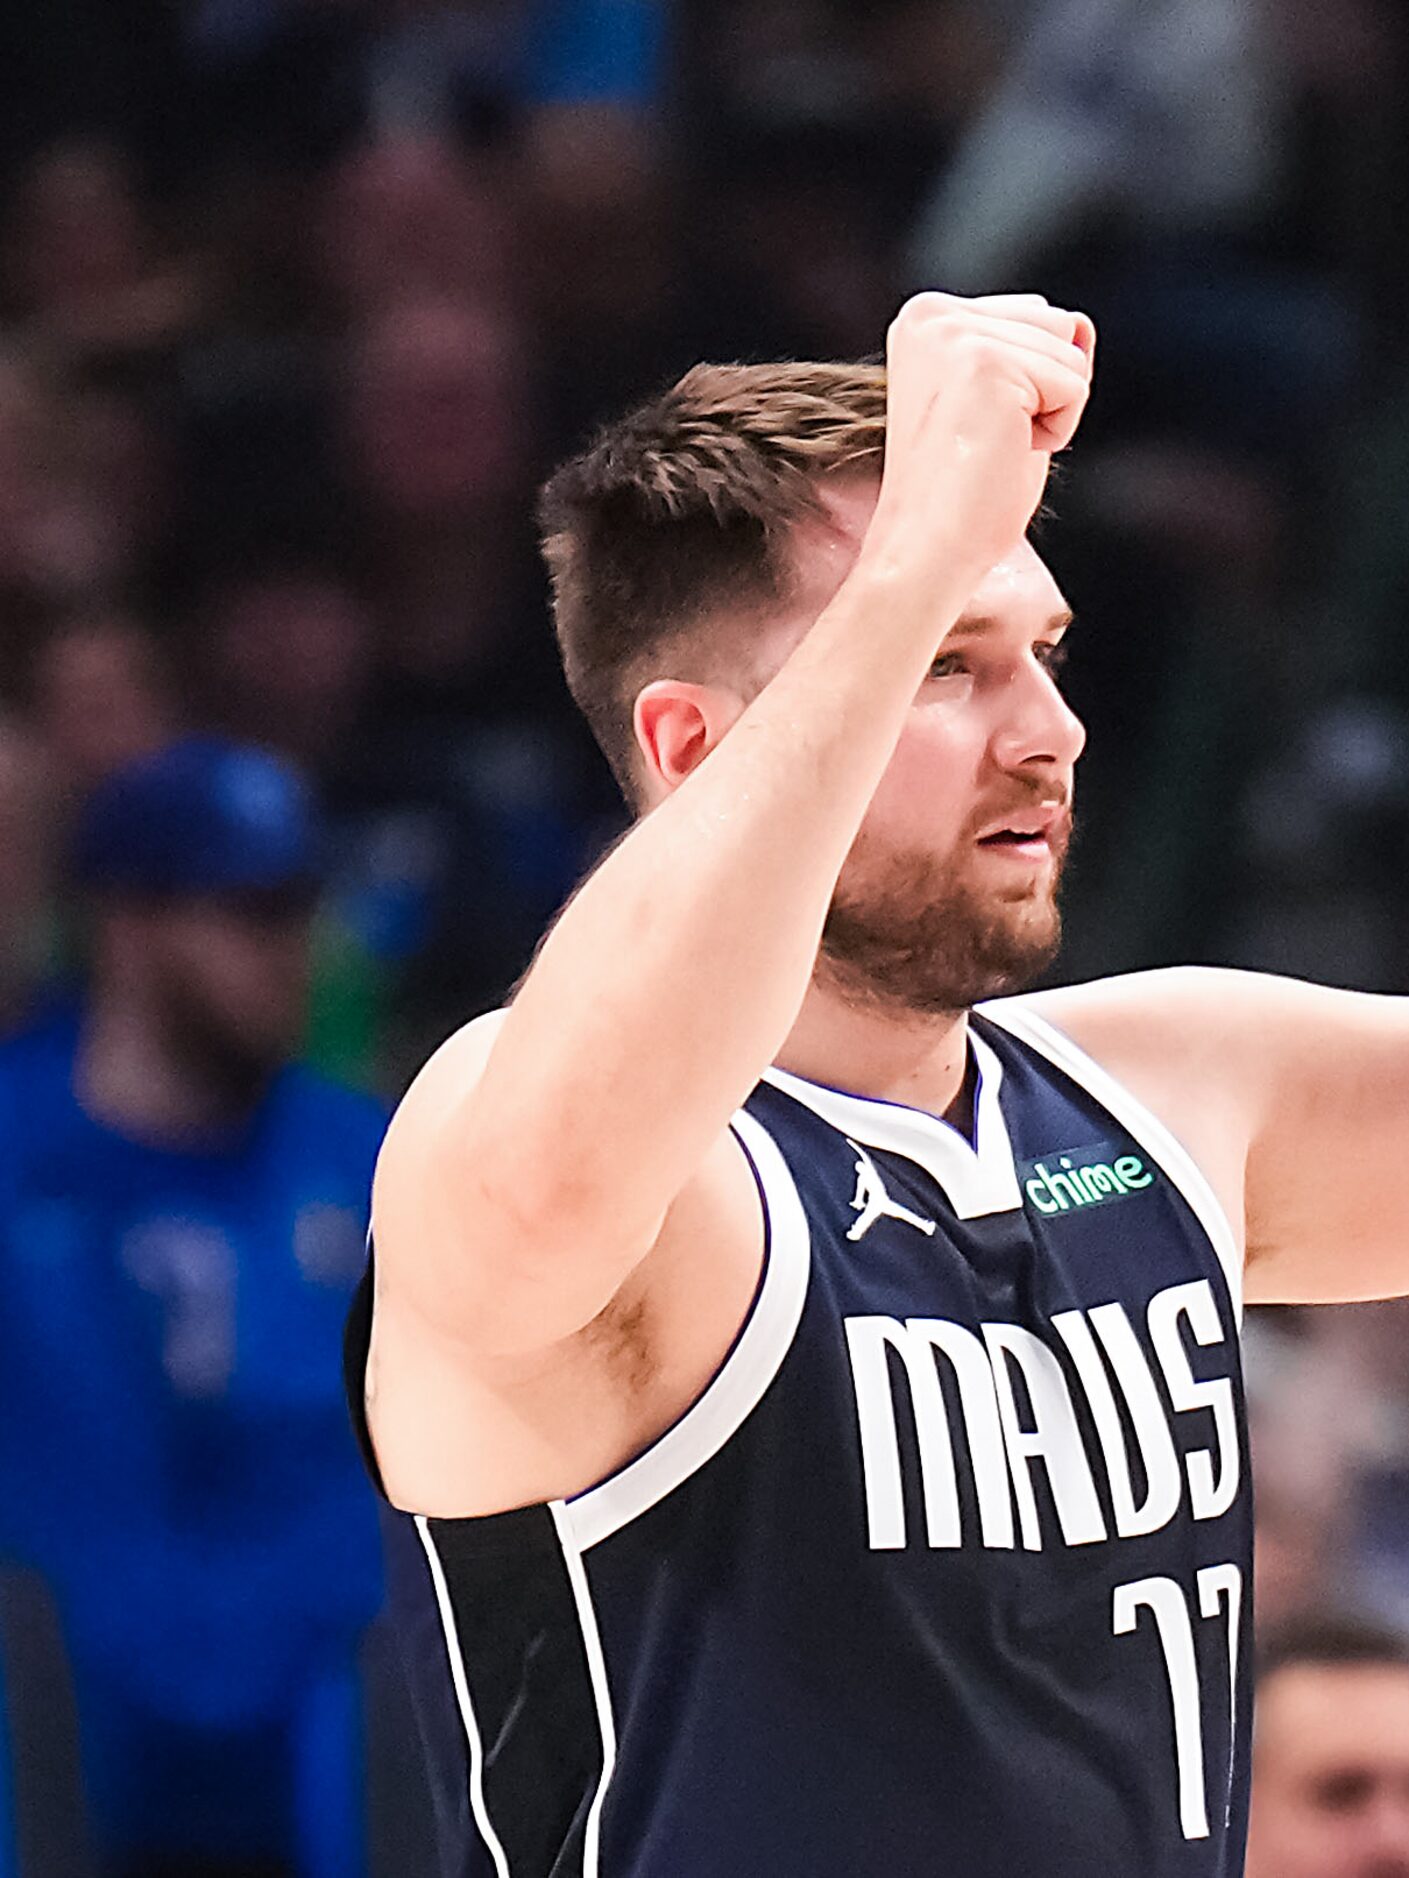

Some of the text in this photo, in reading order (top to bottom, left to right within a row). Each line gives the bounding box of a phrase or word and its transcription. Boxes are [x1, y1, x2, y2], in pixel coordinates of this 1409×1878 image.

[1026, 1156, 1153, 1213] chime
[844, 1279, 1240, 1551] MAVS
[1113, 1563, 1241, 1840] 77
